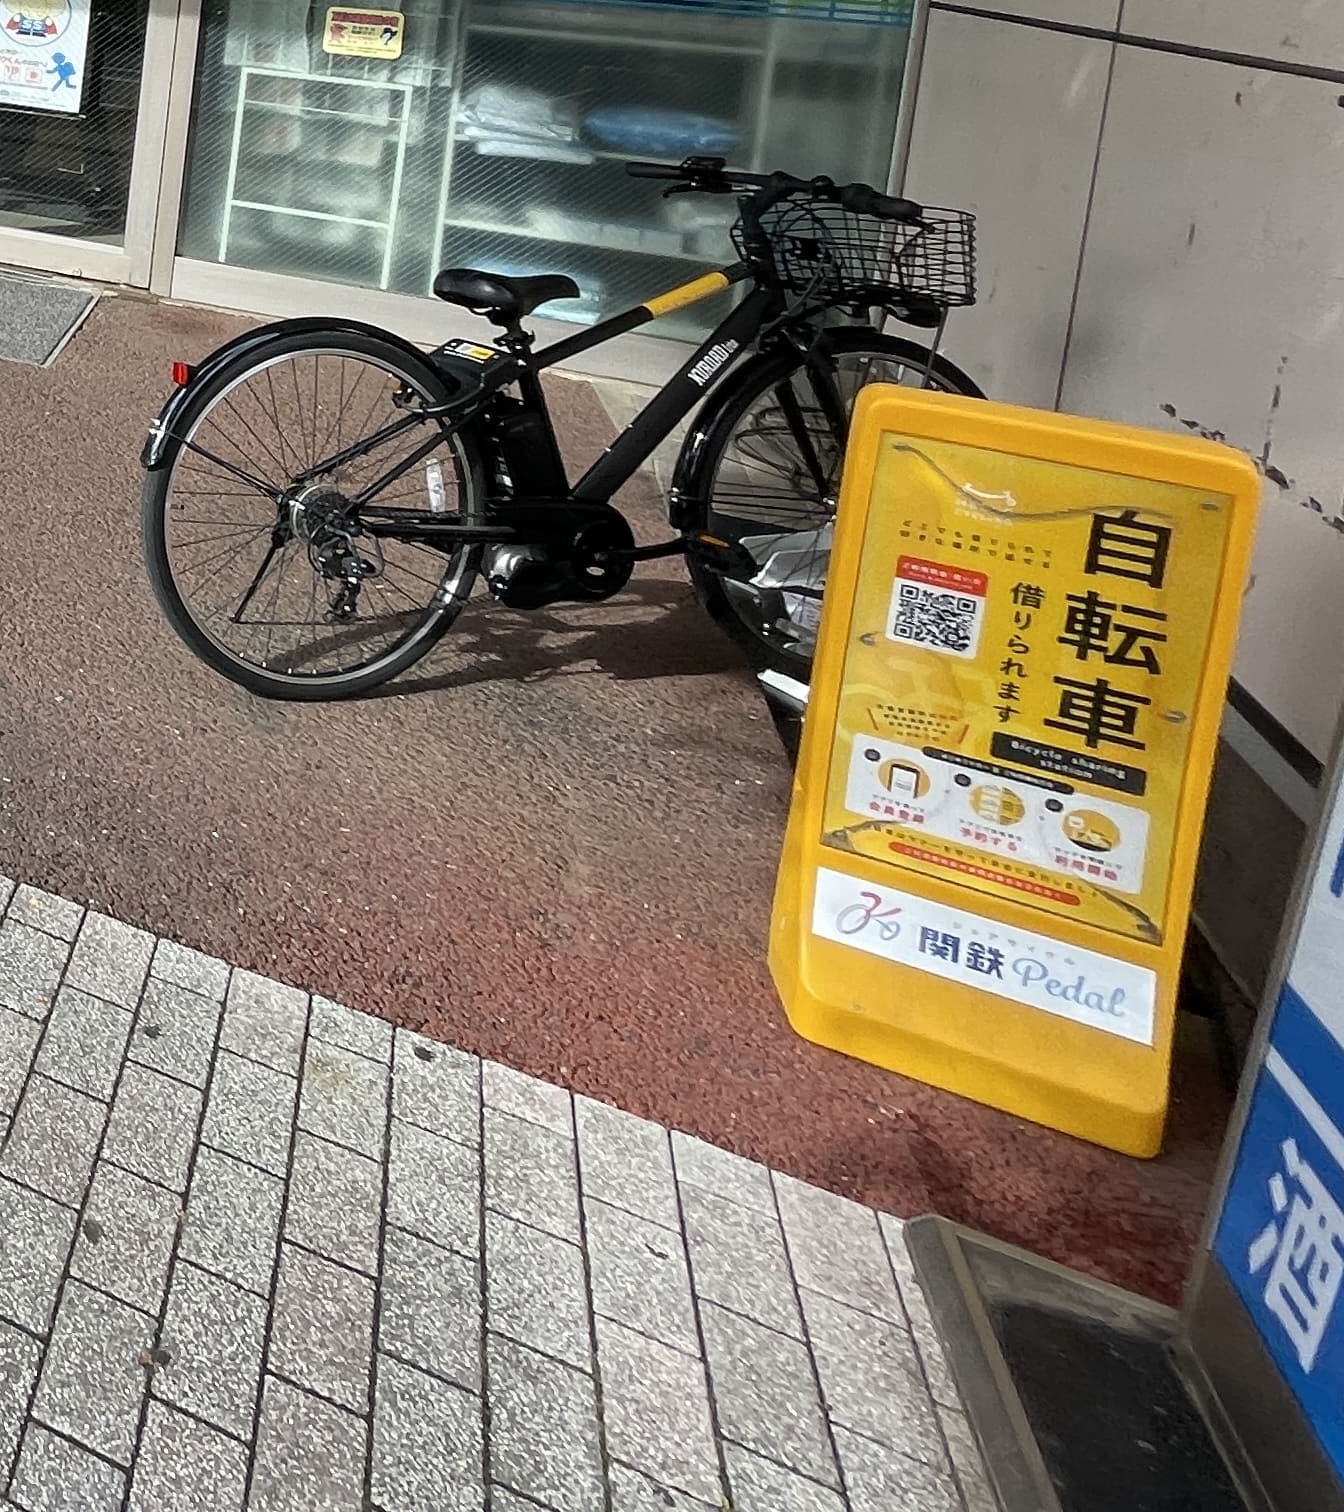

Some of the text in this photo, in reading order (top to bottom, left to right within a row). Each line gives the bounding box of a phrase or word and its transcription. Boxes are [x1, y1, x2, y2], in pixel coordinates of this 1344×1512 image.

[993, 582, 1045, 724] 借りられます
[1043, 508, 1172, 750] 自転車
[918, 925, 1127, 1018] 関鉄 Pedal
